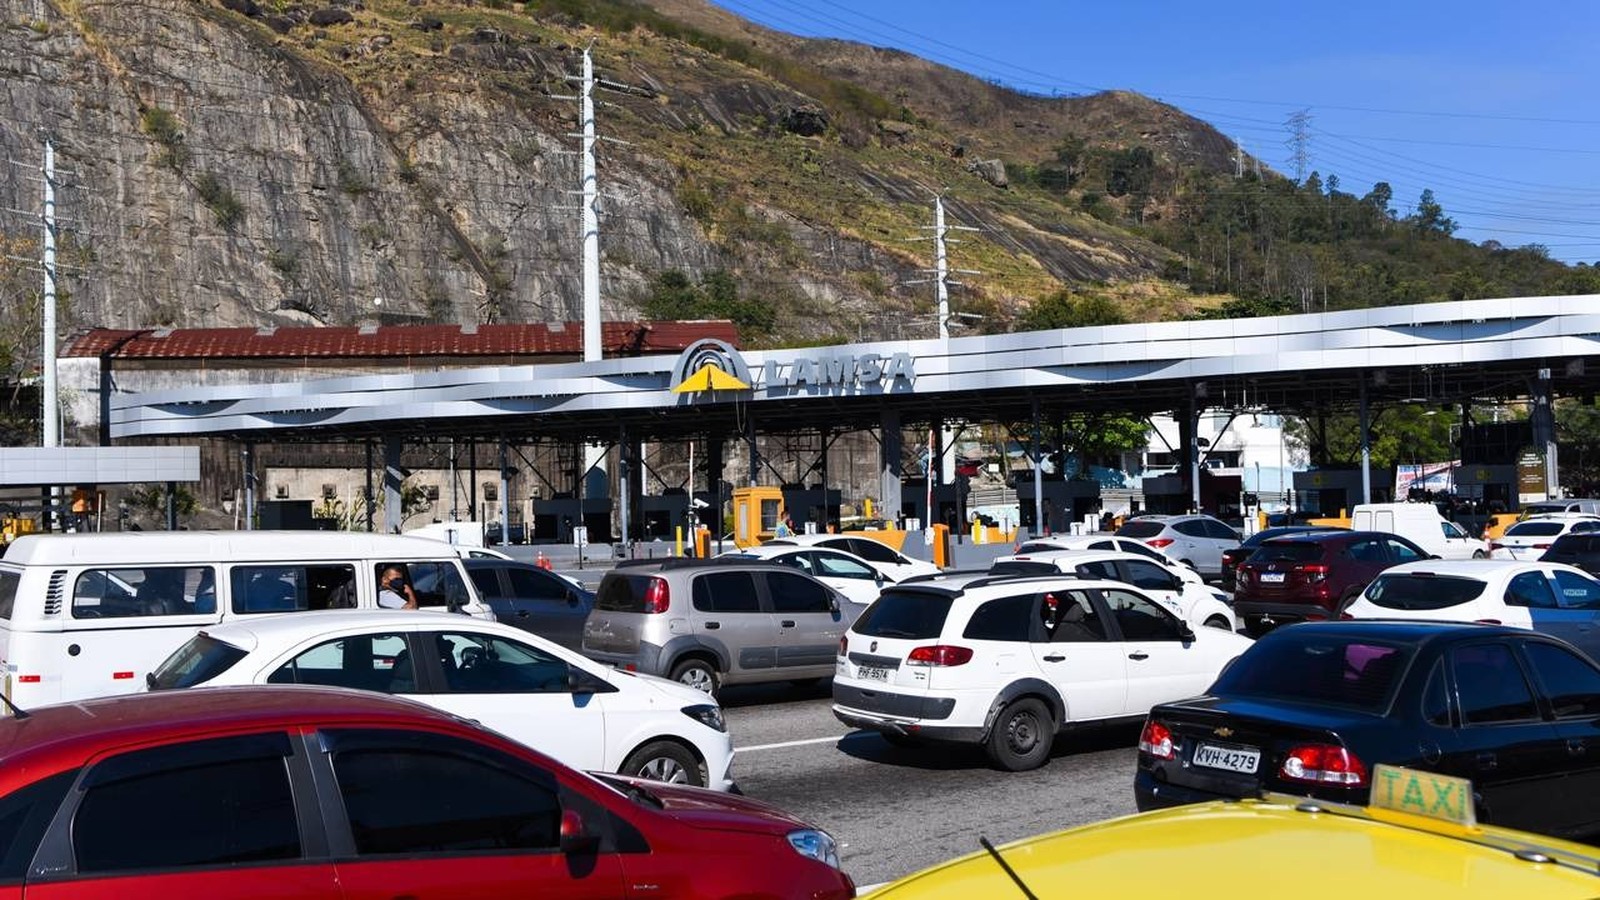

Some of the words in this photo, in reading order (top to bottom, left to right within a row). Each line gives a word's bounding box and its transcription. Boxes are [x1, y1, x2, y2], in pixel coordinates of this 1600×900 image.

[764, 352, 917, 386] LAMSA
[1196, 749, 1256, 770] KVH-4279
[1380, 769, 1467, 821] TAXI
